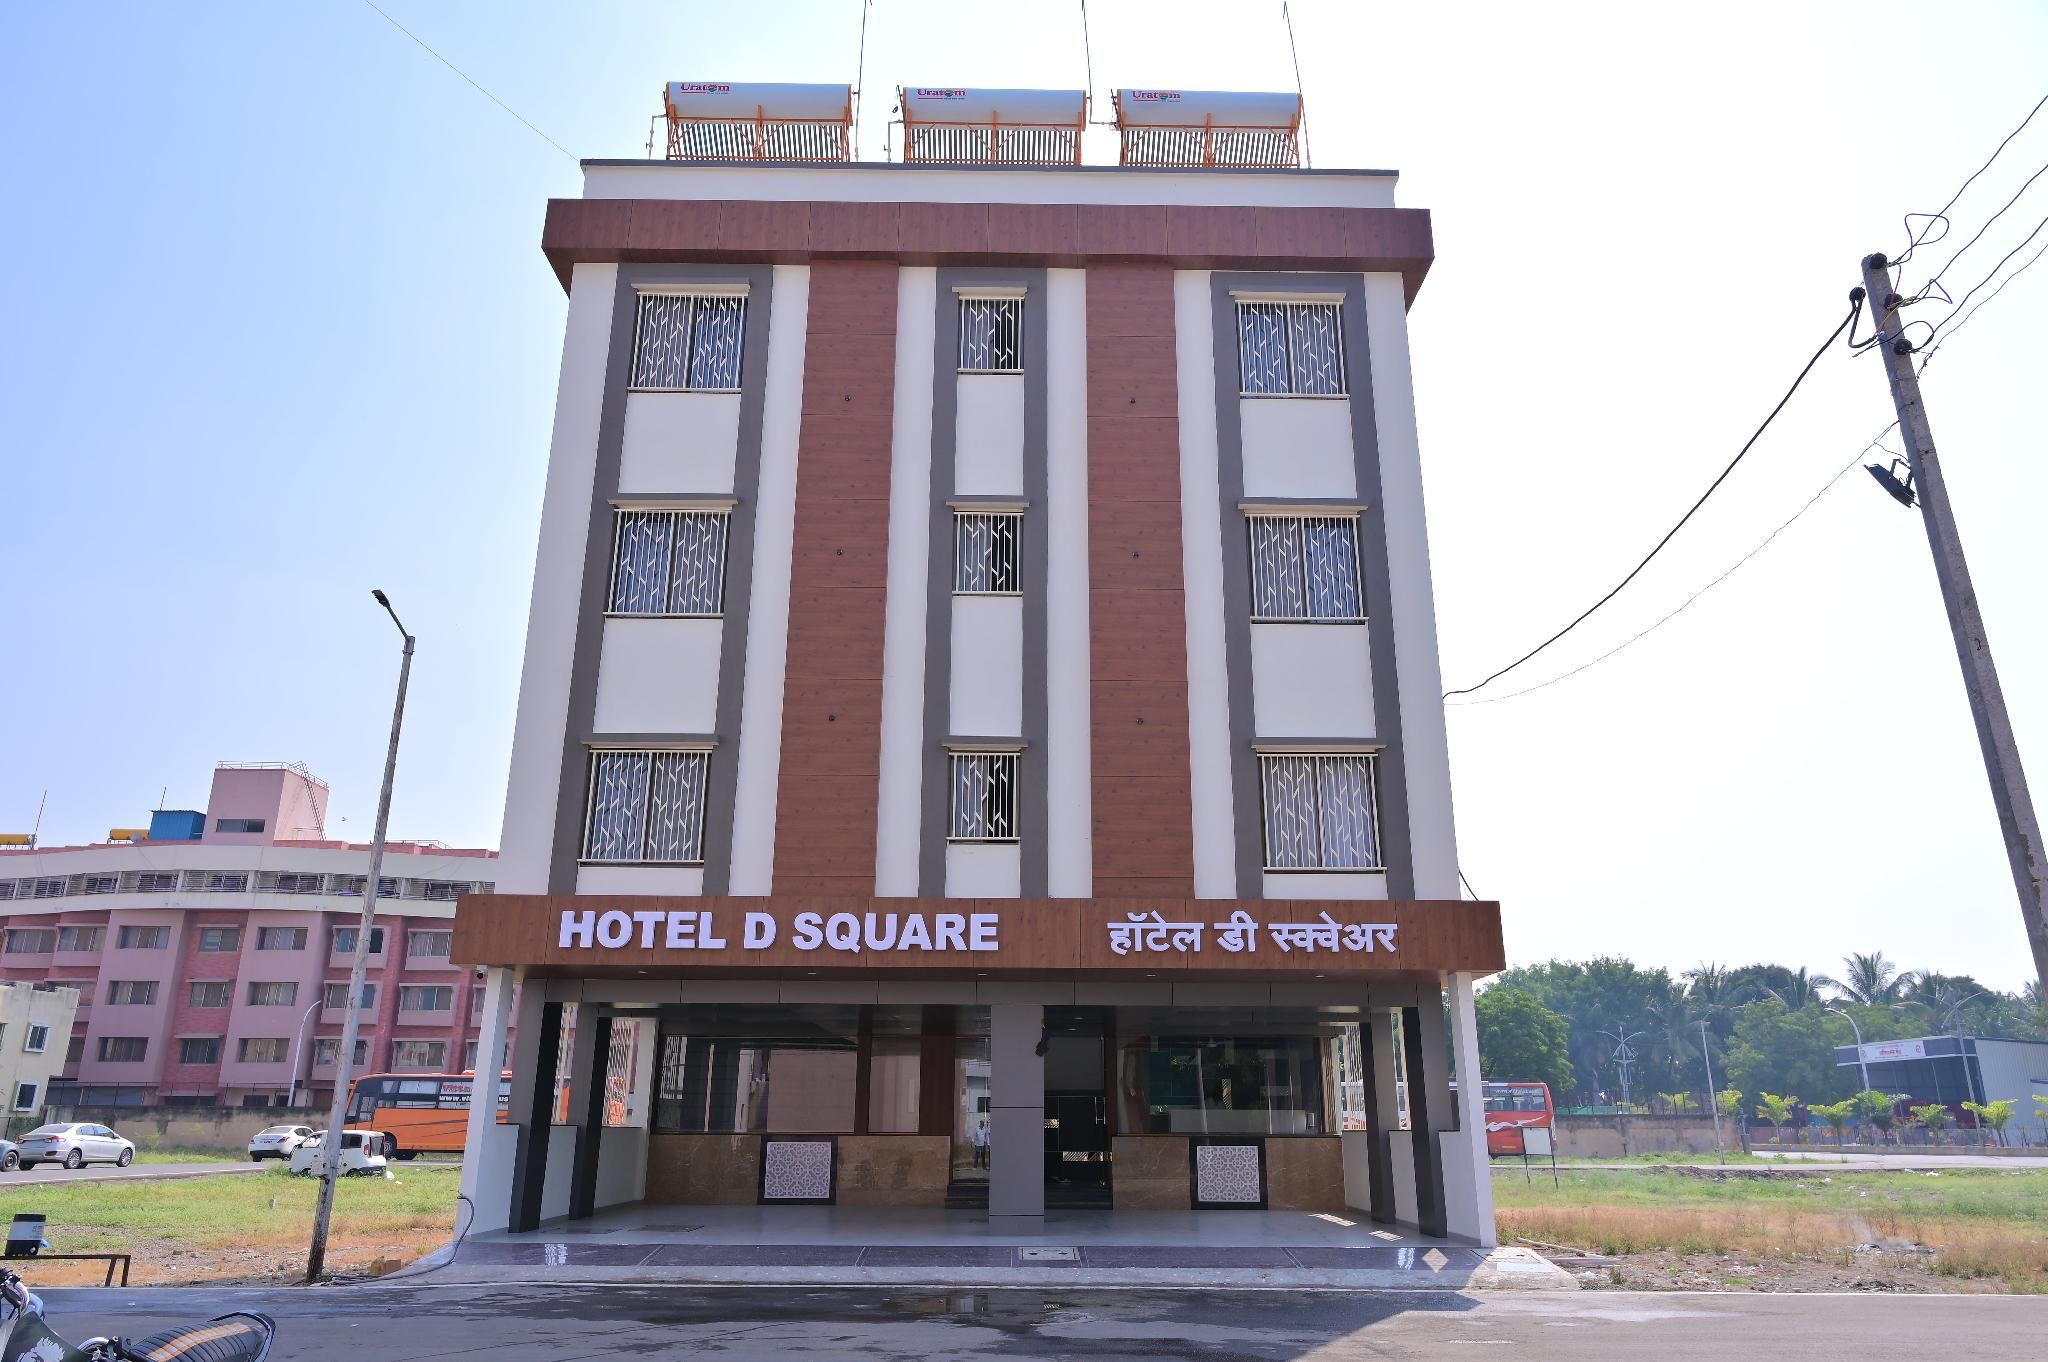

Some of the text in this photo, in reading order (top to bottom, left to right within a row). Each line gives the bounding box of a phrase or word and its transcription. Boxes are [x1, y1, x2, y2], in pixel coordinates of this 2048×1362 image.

[558, 910, 999, 954] HOTEL D SQUARE
[1106, 909, 1398, 956] हॉटेल डी स्क्वेअर
